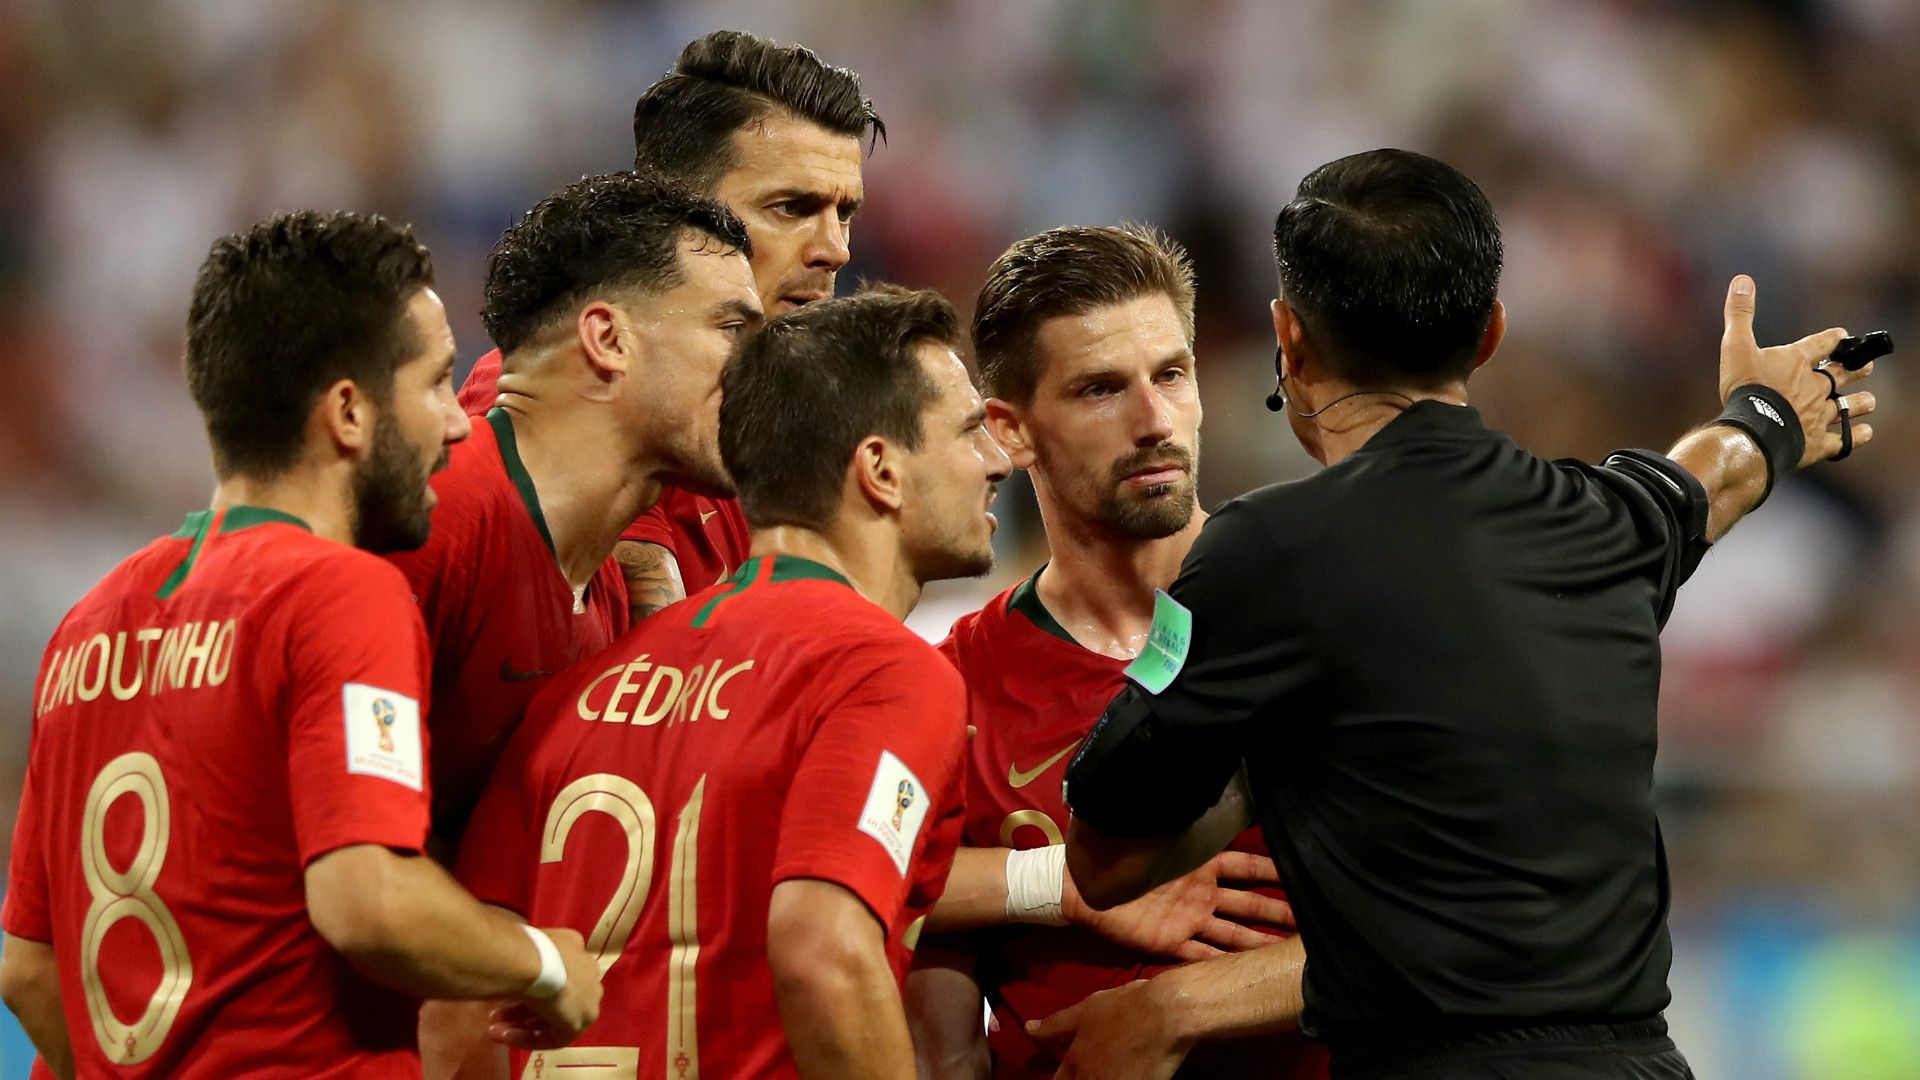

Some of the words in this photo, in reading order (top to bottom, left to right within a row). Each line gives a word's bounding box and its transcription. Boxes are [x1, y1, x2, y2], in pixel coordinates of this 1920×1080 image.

[1748, 396, 1784, 427] adidas
[577, 654, 755, 728] CÉDRIC
[81, 752, 192, 1065] 8
[521, 773, 706, 1080] 21
